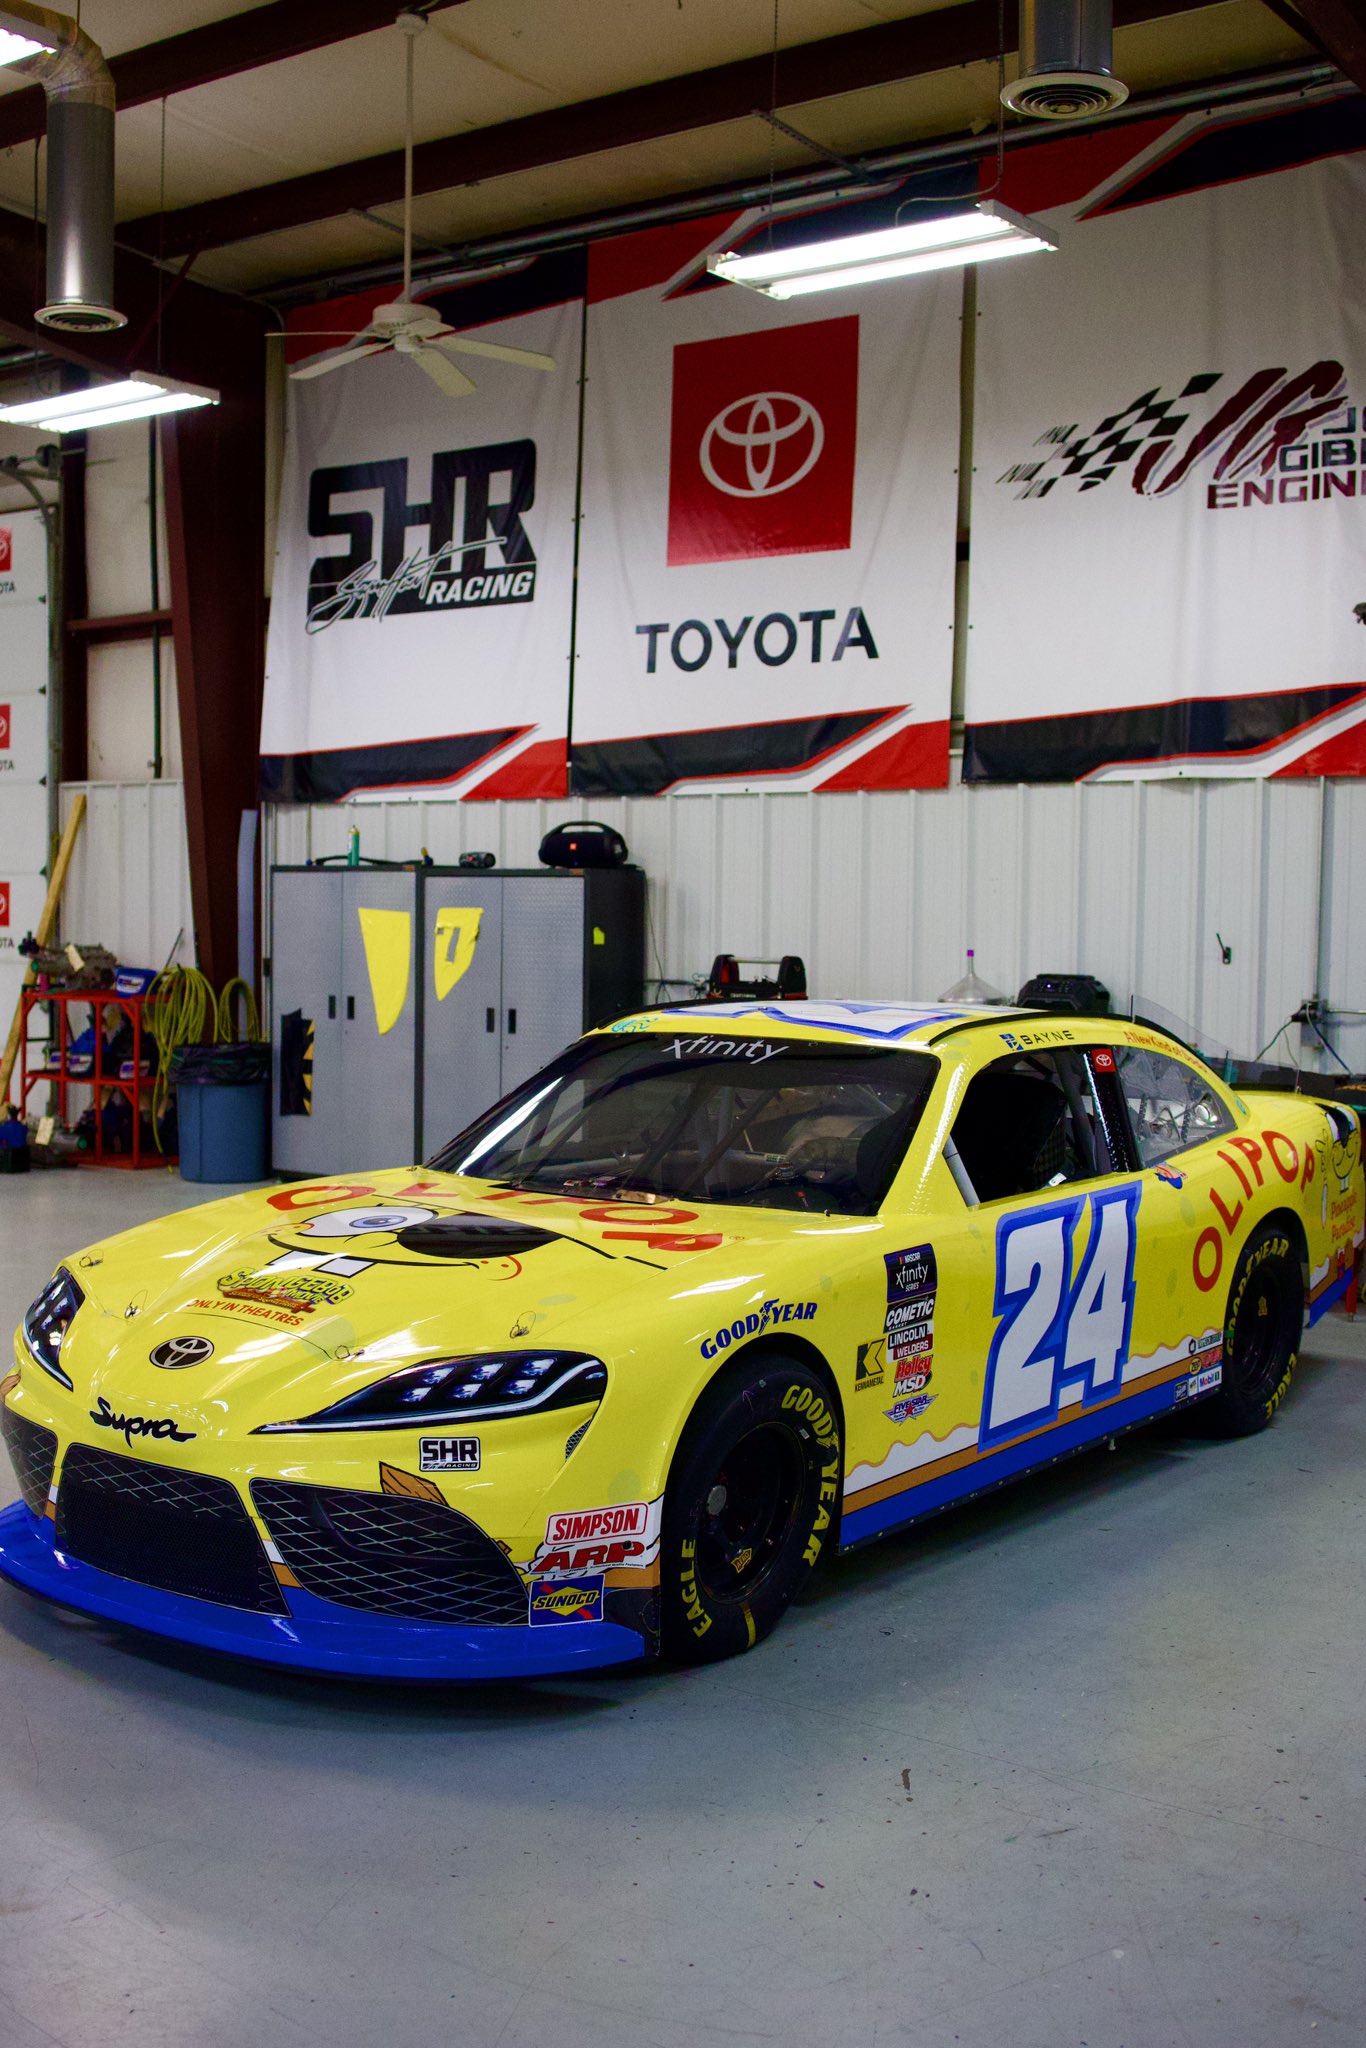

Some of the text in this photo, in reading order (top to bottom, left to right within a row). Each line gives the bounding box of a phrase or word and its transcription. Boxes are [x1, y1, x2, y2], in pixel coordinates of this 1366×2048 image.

[1322, 405, 1366, 435] J
[1279, 438, 1366, 473] GIB
[1207, 470, 1366, 509] ENGIN
[307, 438, 537, 620] SHR
[425, 571, 534, 604] RACING
[635, 606, 880, 673] TOYOTA
[661, 1034, 790, 1065] xfinity
[1020, 1030, 1075, 1045] BAYNE
[1192, 1130, 1316, 1293] OLIPOP
[904, 1251, 921, 1264] NASCAR
[895, 1262, 929, 1289] xfinity
[905, 1281, 920, 1292] SERIES
[187, 1299, 222, 1309] ONLY
[224, 1301, 237, 1312] IN
[238, 1304, 304, 1327] THEATRES
[886, 1298, 935, 1328] COMETIC
[981, 1187, 1137, 1443] 24
[700, 1300, 818, 1360] GOODYEAR
[889, 1324, 926, 1347] LINCOLN
[896, 1340, 929, 1359] WELDERS
[896, 1354, 933, 1380] Holley
[854, 1376, 884, 1393] KENNAMETAL
[893, 1373, 928, 1398] MSD
[1265, 1352, 1297, 1420] EAGLE
[894, 1400, 912, 1414] FIVE
[911, 1393, 929, 1406] STAR
[89, 1396, 197, 1449] Supra
[422, 1440, 478, 1462] SHR
[552, 1507, 640, 1542] SIMPSON
[532, 1541, 645, 1573] ARP
[534, 1591, 597, 1611] SUNOCO
[681, 1538, 713, 1638] EAGLE
